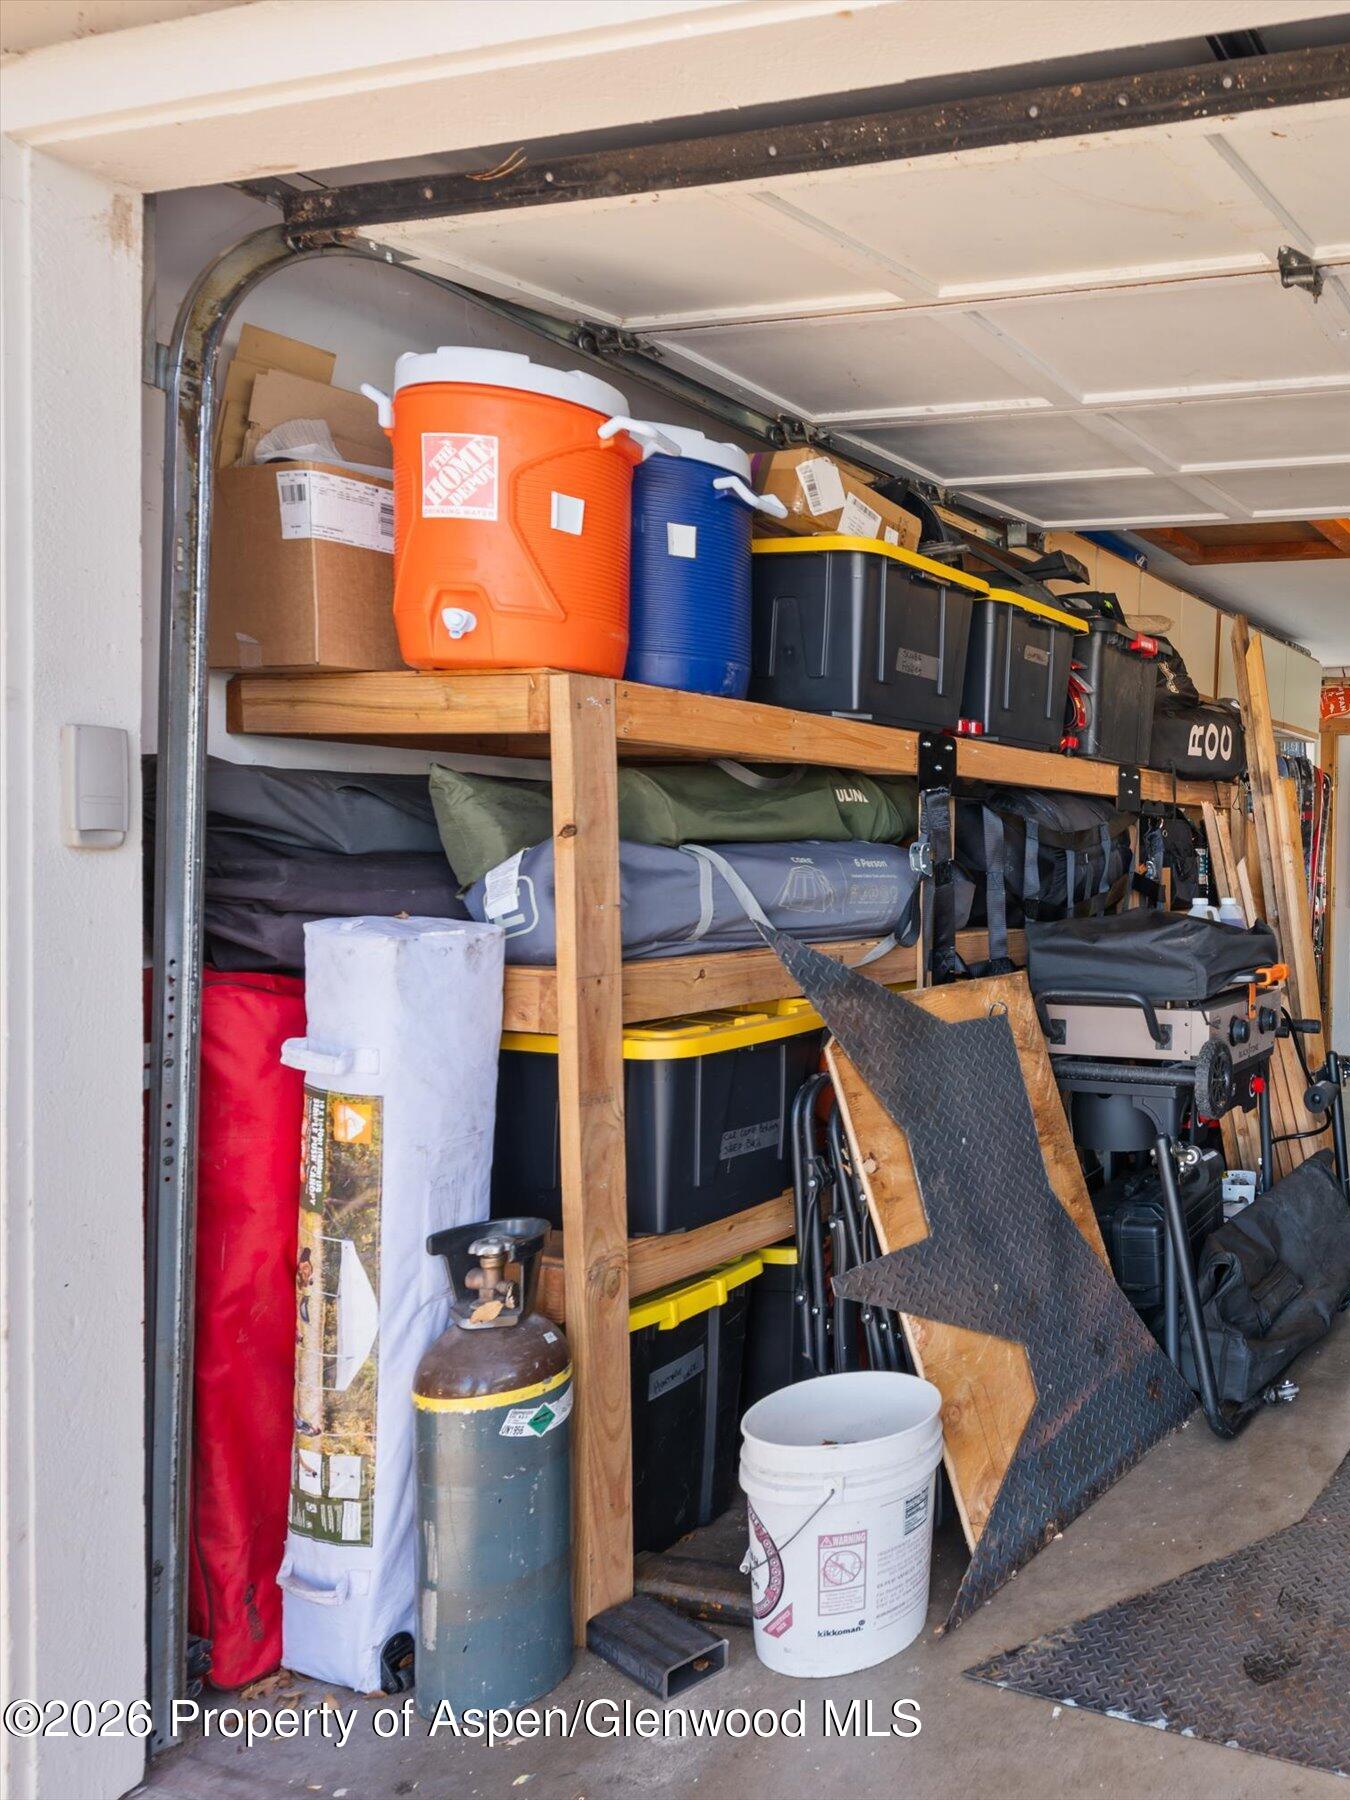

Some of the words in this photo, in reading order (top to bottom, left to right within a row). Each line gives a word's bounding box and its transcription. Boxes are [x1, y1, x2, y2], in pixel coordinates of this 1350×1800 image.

[428, 443, 458, 471] THE
[425, 439, 494, 505] HOME
[447, 464, 496, 507] DEPOT
[1338, 696, 1347, 712] FAN
[862, 858, 888, 869] Person
[312, 1098, 320, 1134] SIMPLE
[310, 1135, 319, 1162] PUSH
[309, 1165, 318, 1206] CANOPY
[832, 1531, 866, 1547] WARNING
